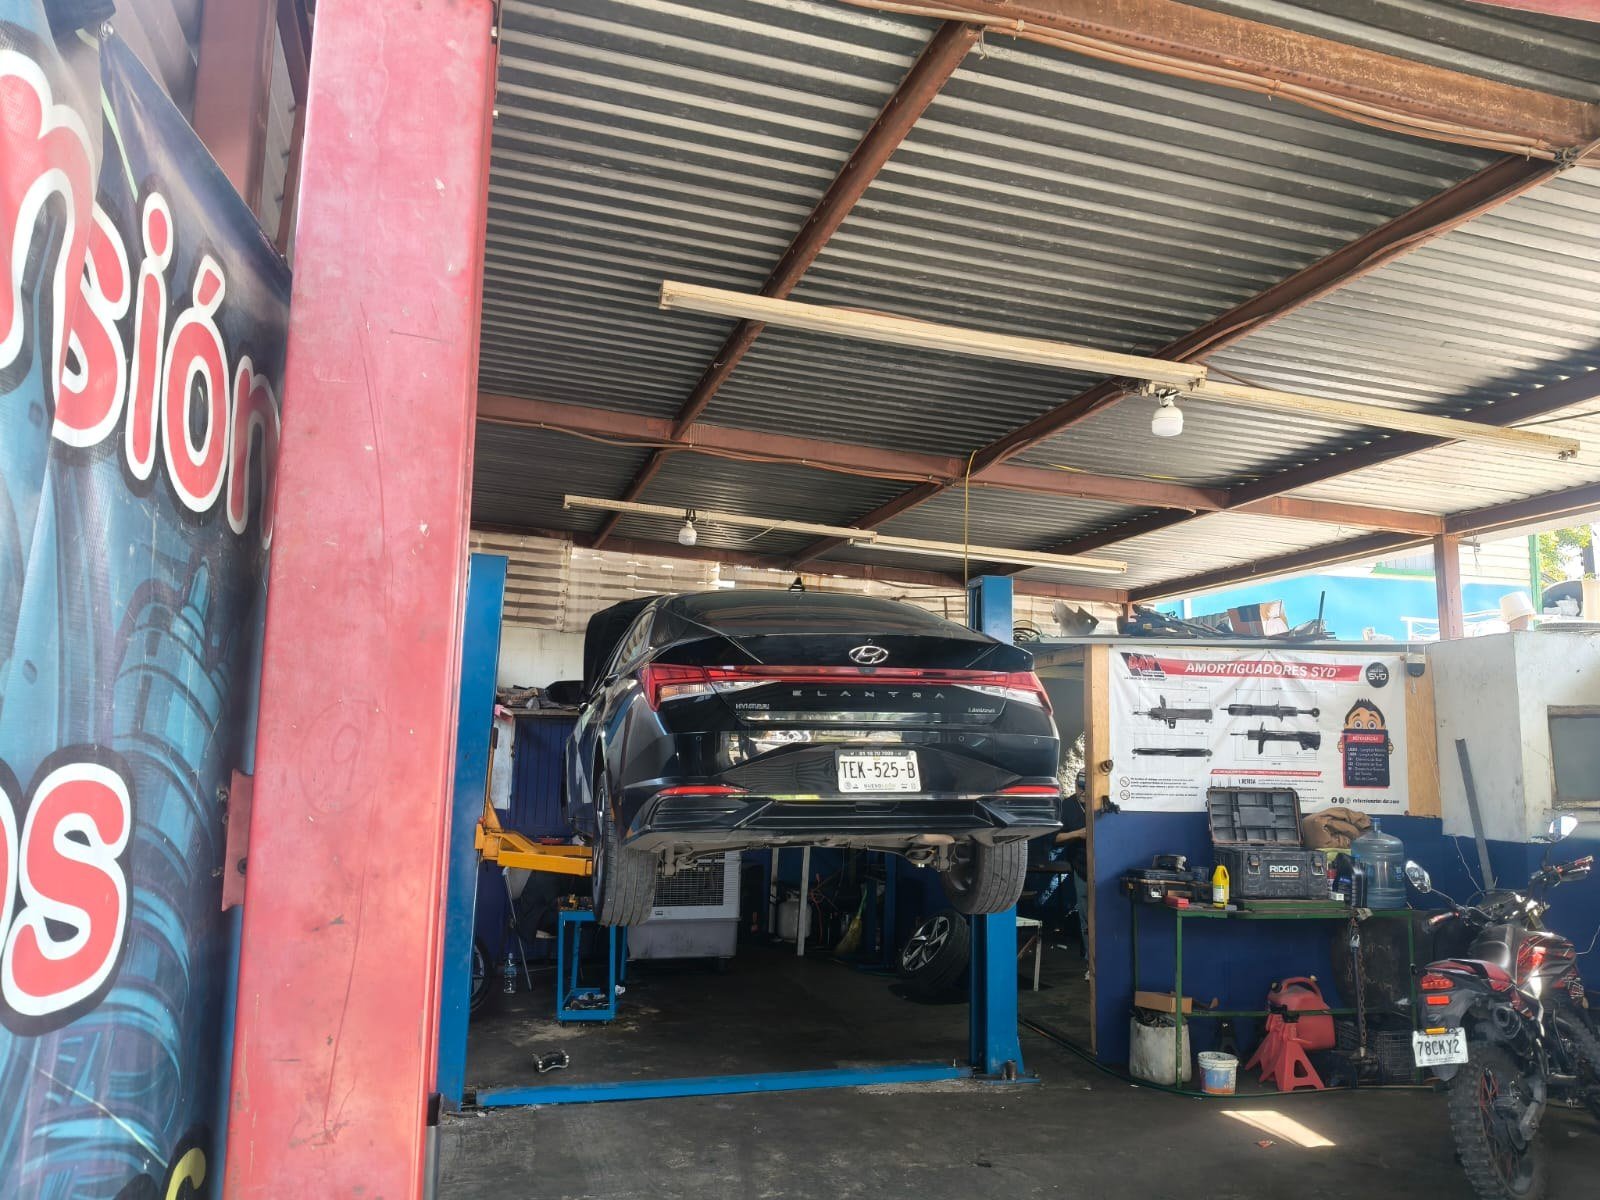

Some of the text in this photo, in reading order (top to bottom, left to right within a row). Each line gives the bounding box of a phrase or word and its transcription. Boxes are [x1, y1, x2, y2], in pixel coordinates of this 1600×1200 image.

[1184, 662, 1308, 677] AMORTIGUADORES
[792, 689, 945, 699] ELANTRA
[839, 761, 916, 779] TEK-525-B
[1416, 1038, 1461, 1057] 78CKY2
